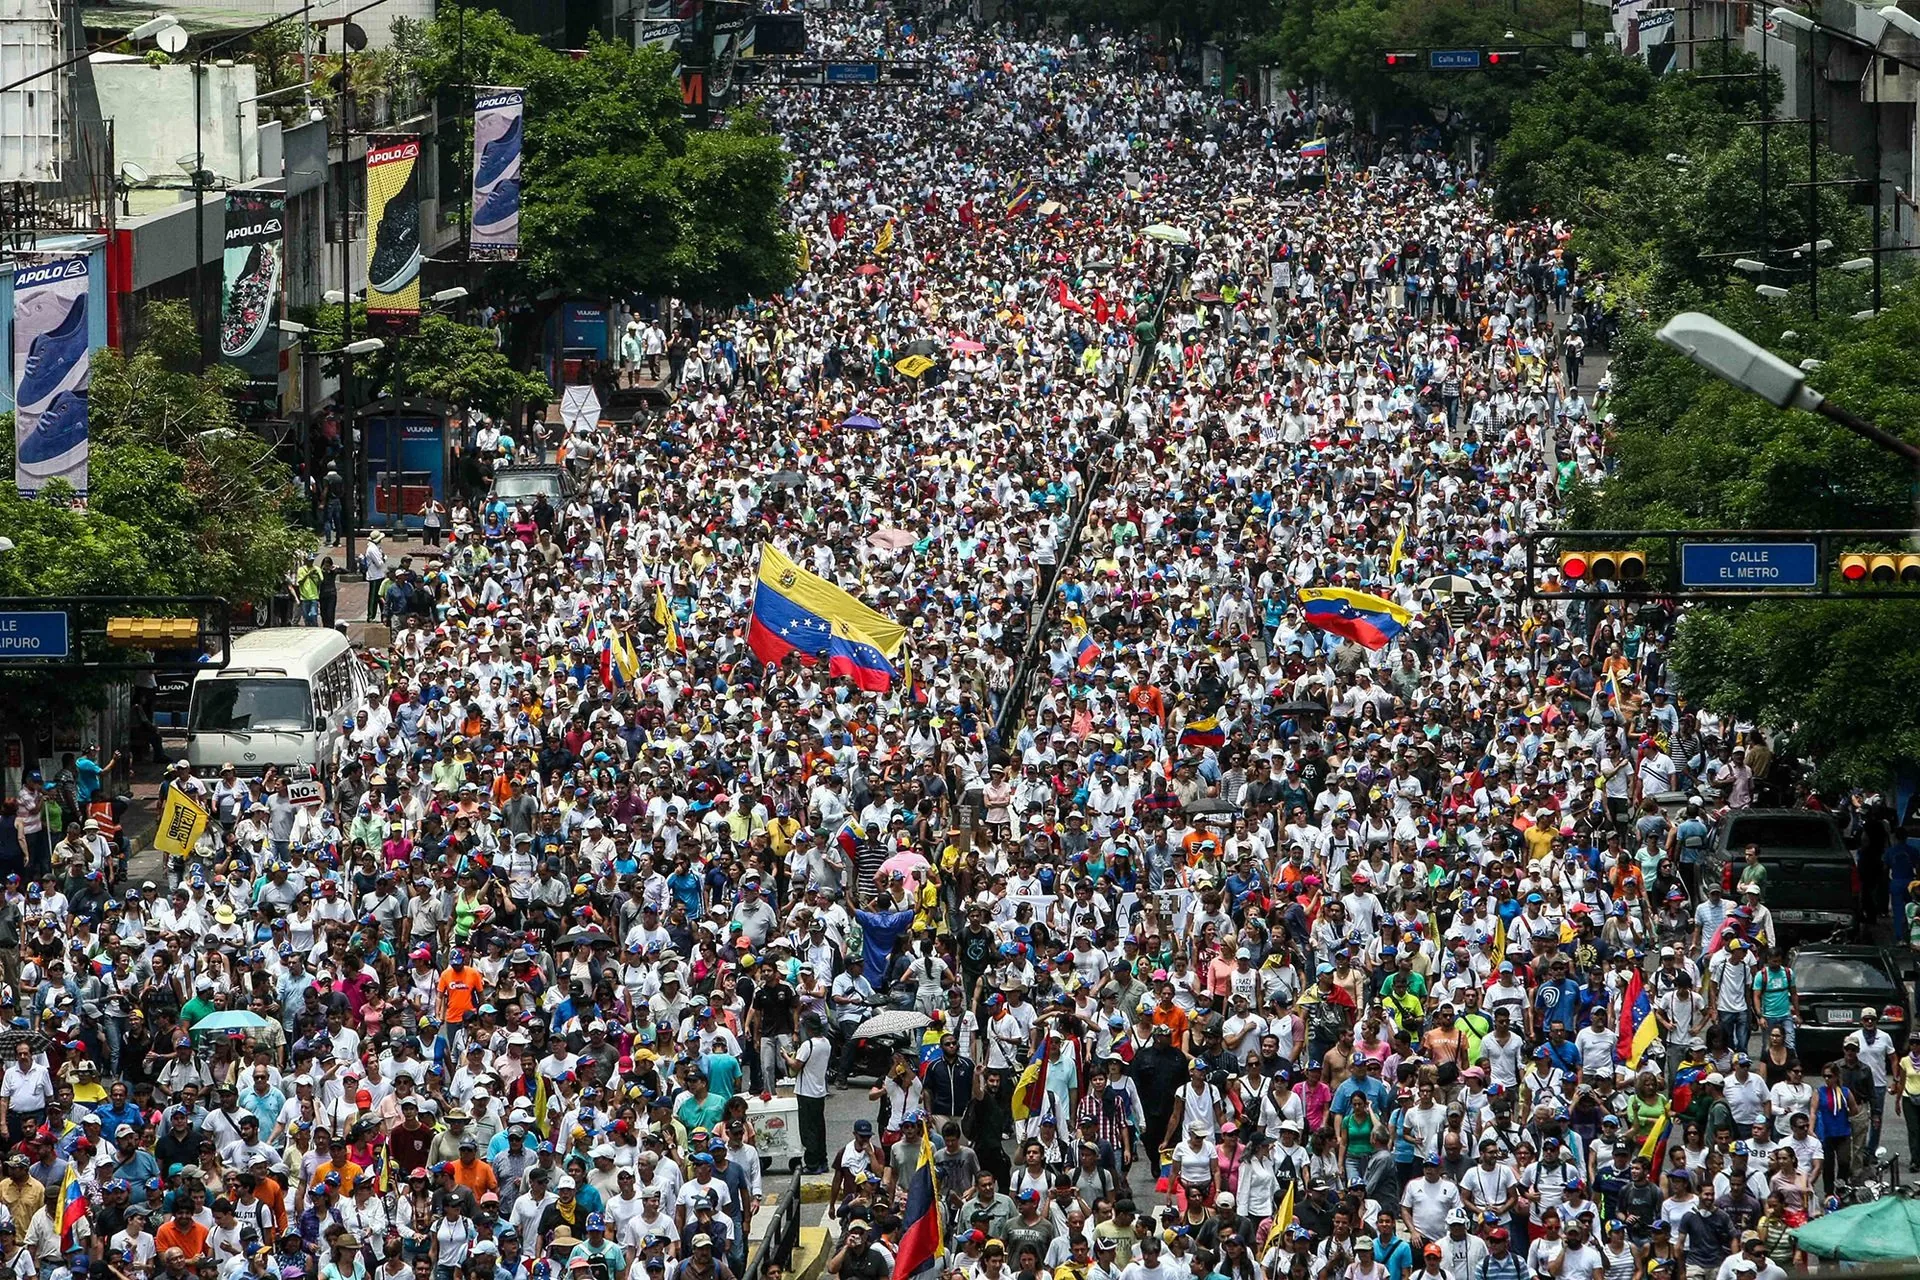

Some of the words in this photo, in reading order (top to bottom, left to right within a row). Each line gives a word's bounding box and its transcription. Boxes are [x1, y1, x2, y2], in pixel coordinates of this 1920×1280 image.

[716, 22, 737, 30] APOLO
[1639, 17, 1662, 29] APOLO
[643, 28, 667, 39] APOLO
[476, 97, 507, 109] APOLO
[368, 150, 401, 164] APOLO
[226, 224, 262, 240] APOLO
[16, 266, 63, 286] APOLO
[1730, 551, 1769, 562] CALLE
[1720, 567, 1735, 578] EL
[1737, 567, 1779, 578] METRO
[0, 620, 17, 631] LE
[0, 637, 41, 649] IPURO
